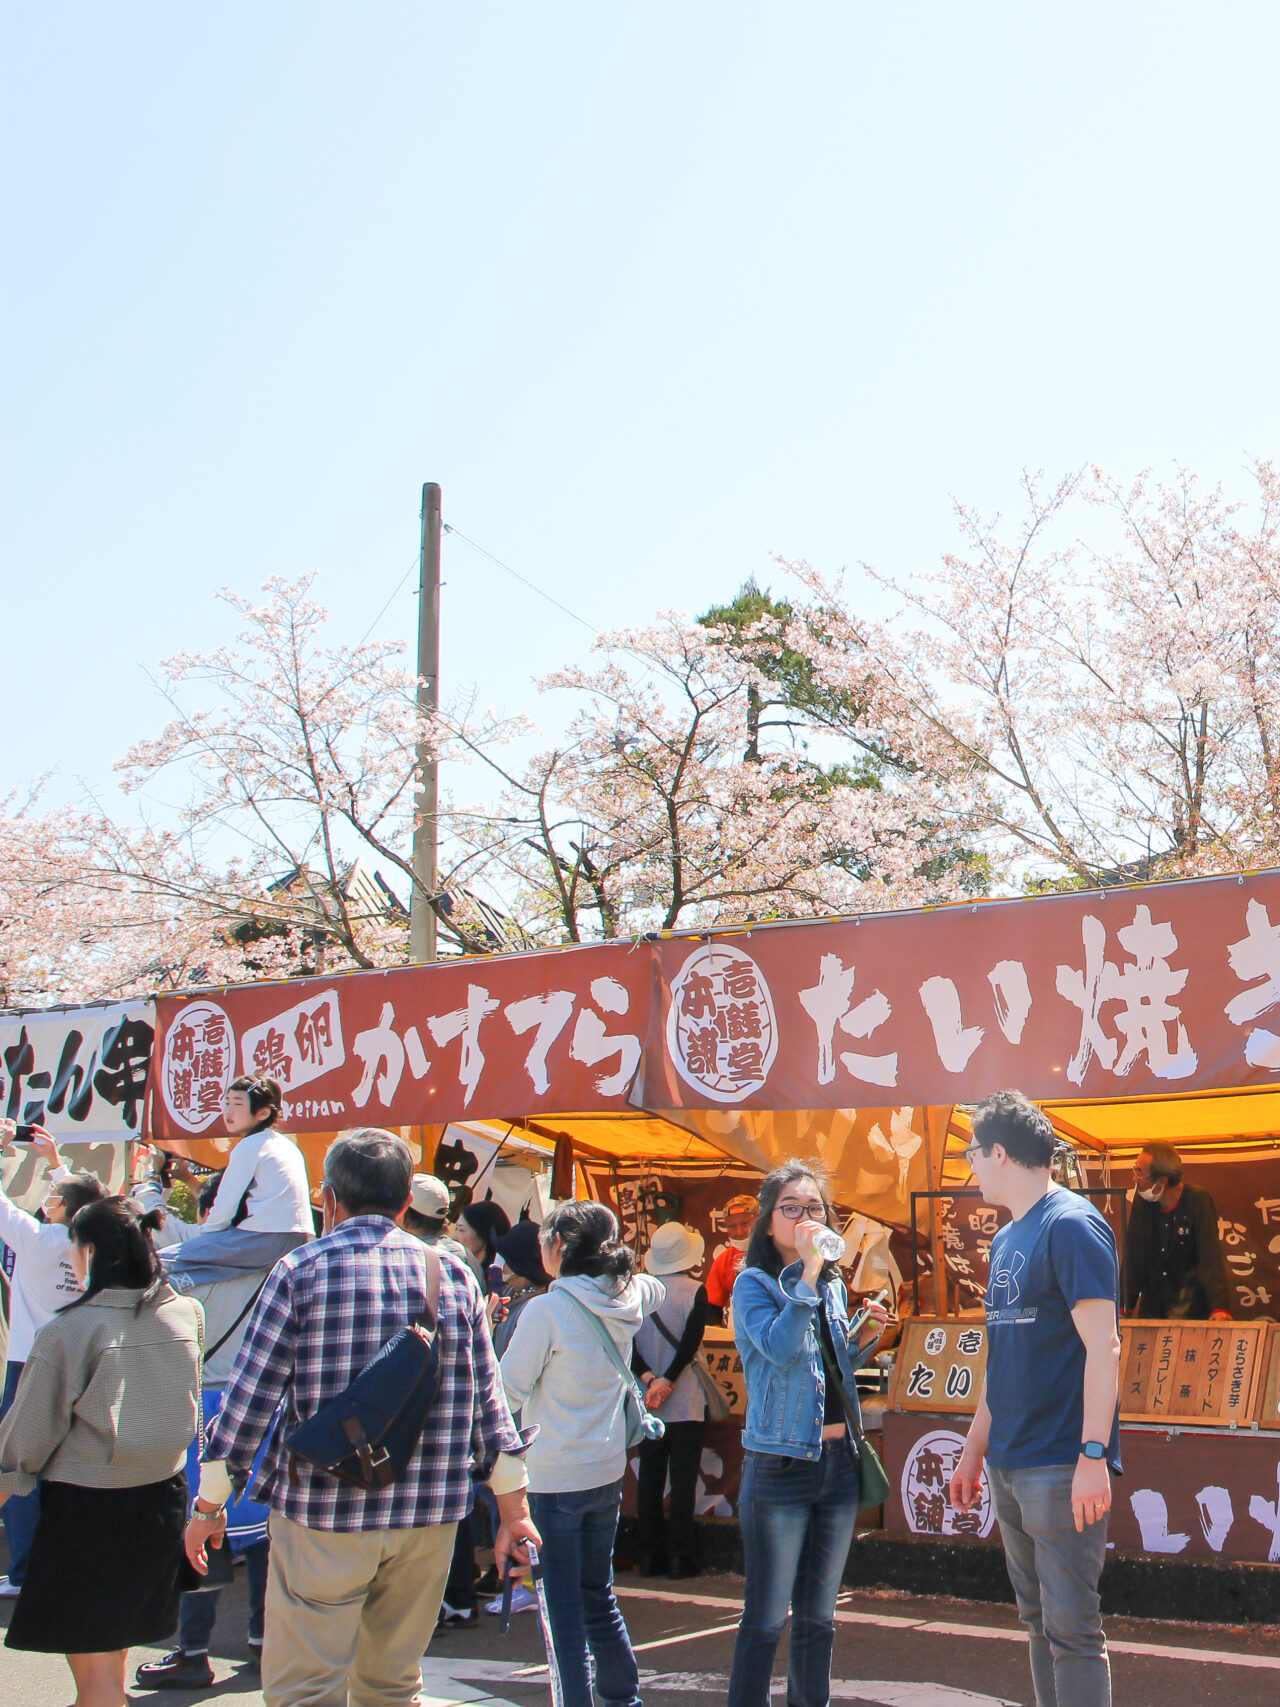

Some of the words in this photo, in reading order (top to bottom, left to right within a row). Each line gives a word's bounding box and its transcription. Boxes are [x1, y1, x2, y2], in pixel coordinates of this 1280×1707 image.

[351, 976, 642, 1110] かすてら
[908, 1363, 972, 1398] たい
[1153, 1335, 1173, 1409] チョコレート
[1228, 1338, 1249, 1408] むらさき芋
